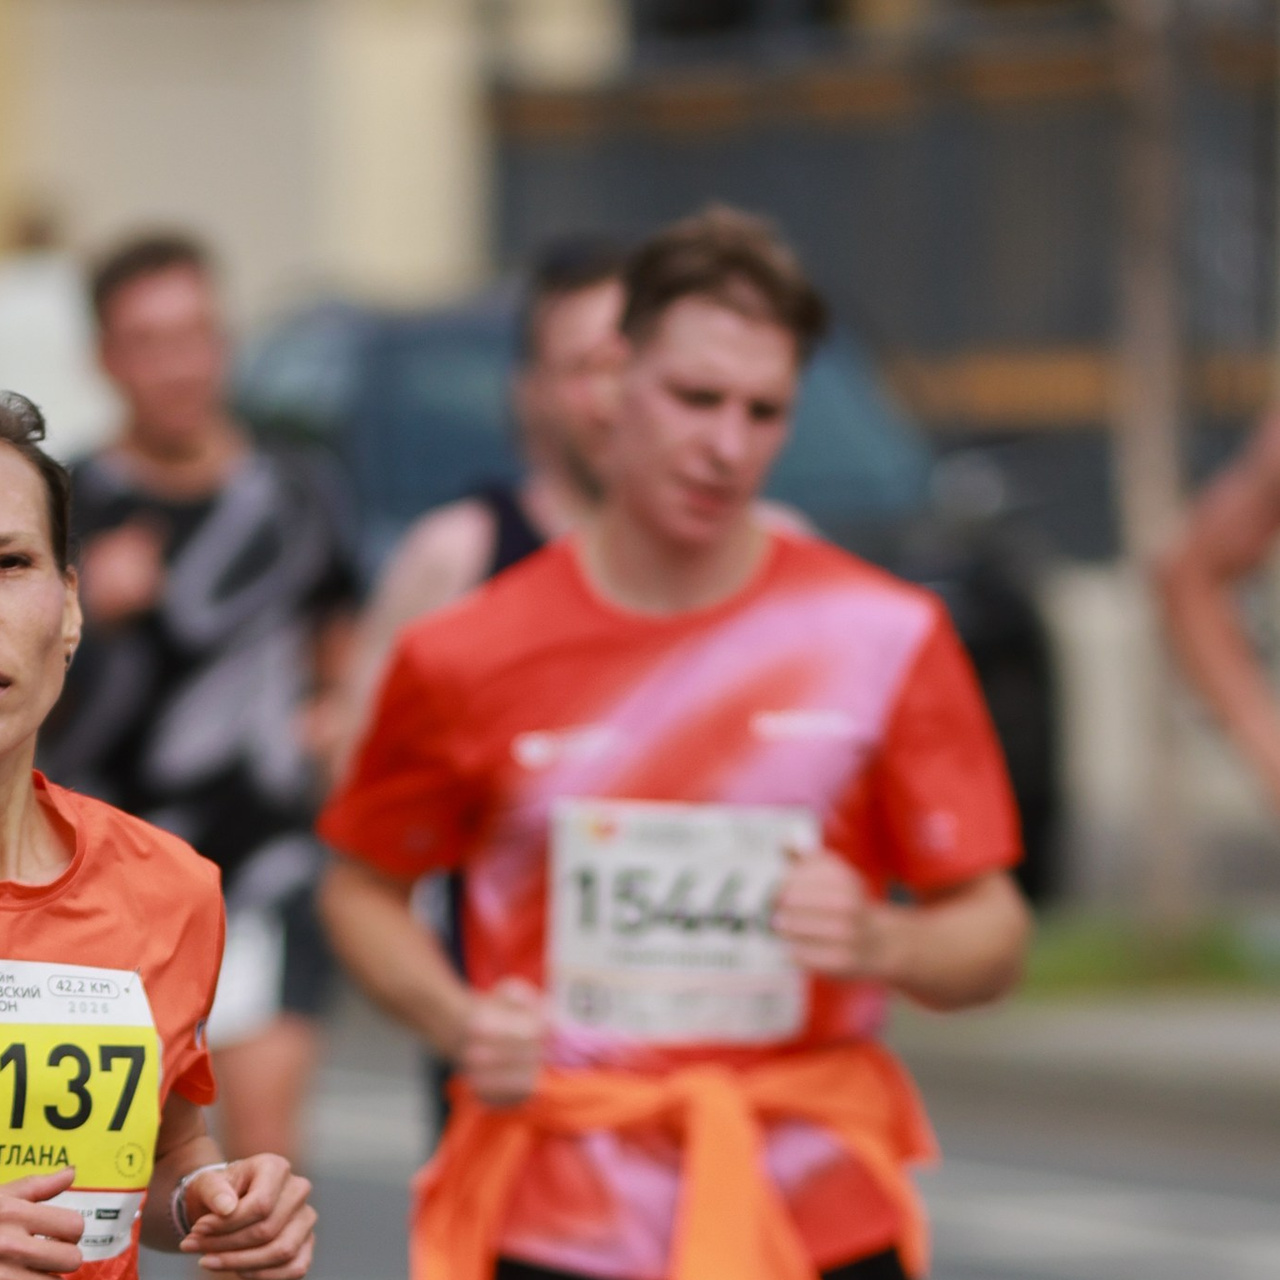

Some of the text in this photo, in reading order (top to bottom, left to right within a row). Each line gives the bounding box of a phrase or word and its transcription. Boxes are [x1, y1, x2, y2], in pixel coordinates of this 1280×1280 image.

[568, 866, 776, 938] 1544
[55, 979, 85, 994] 42,2
[125, 1152, 134, 1167] 1
